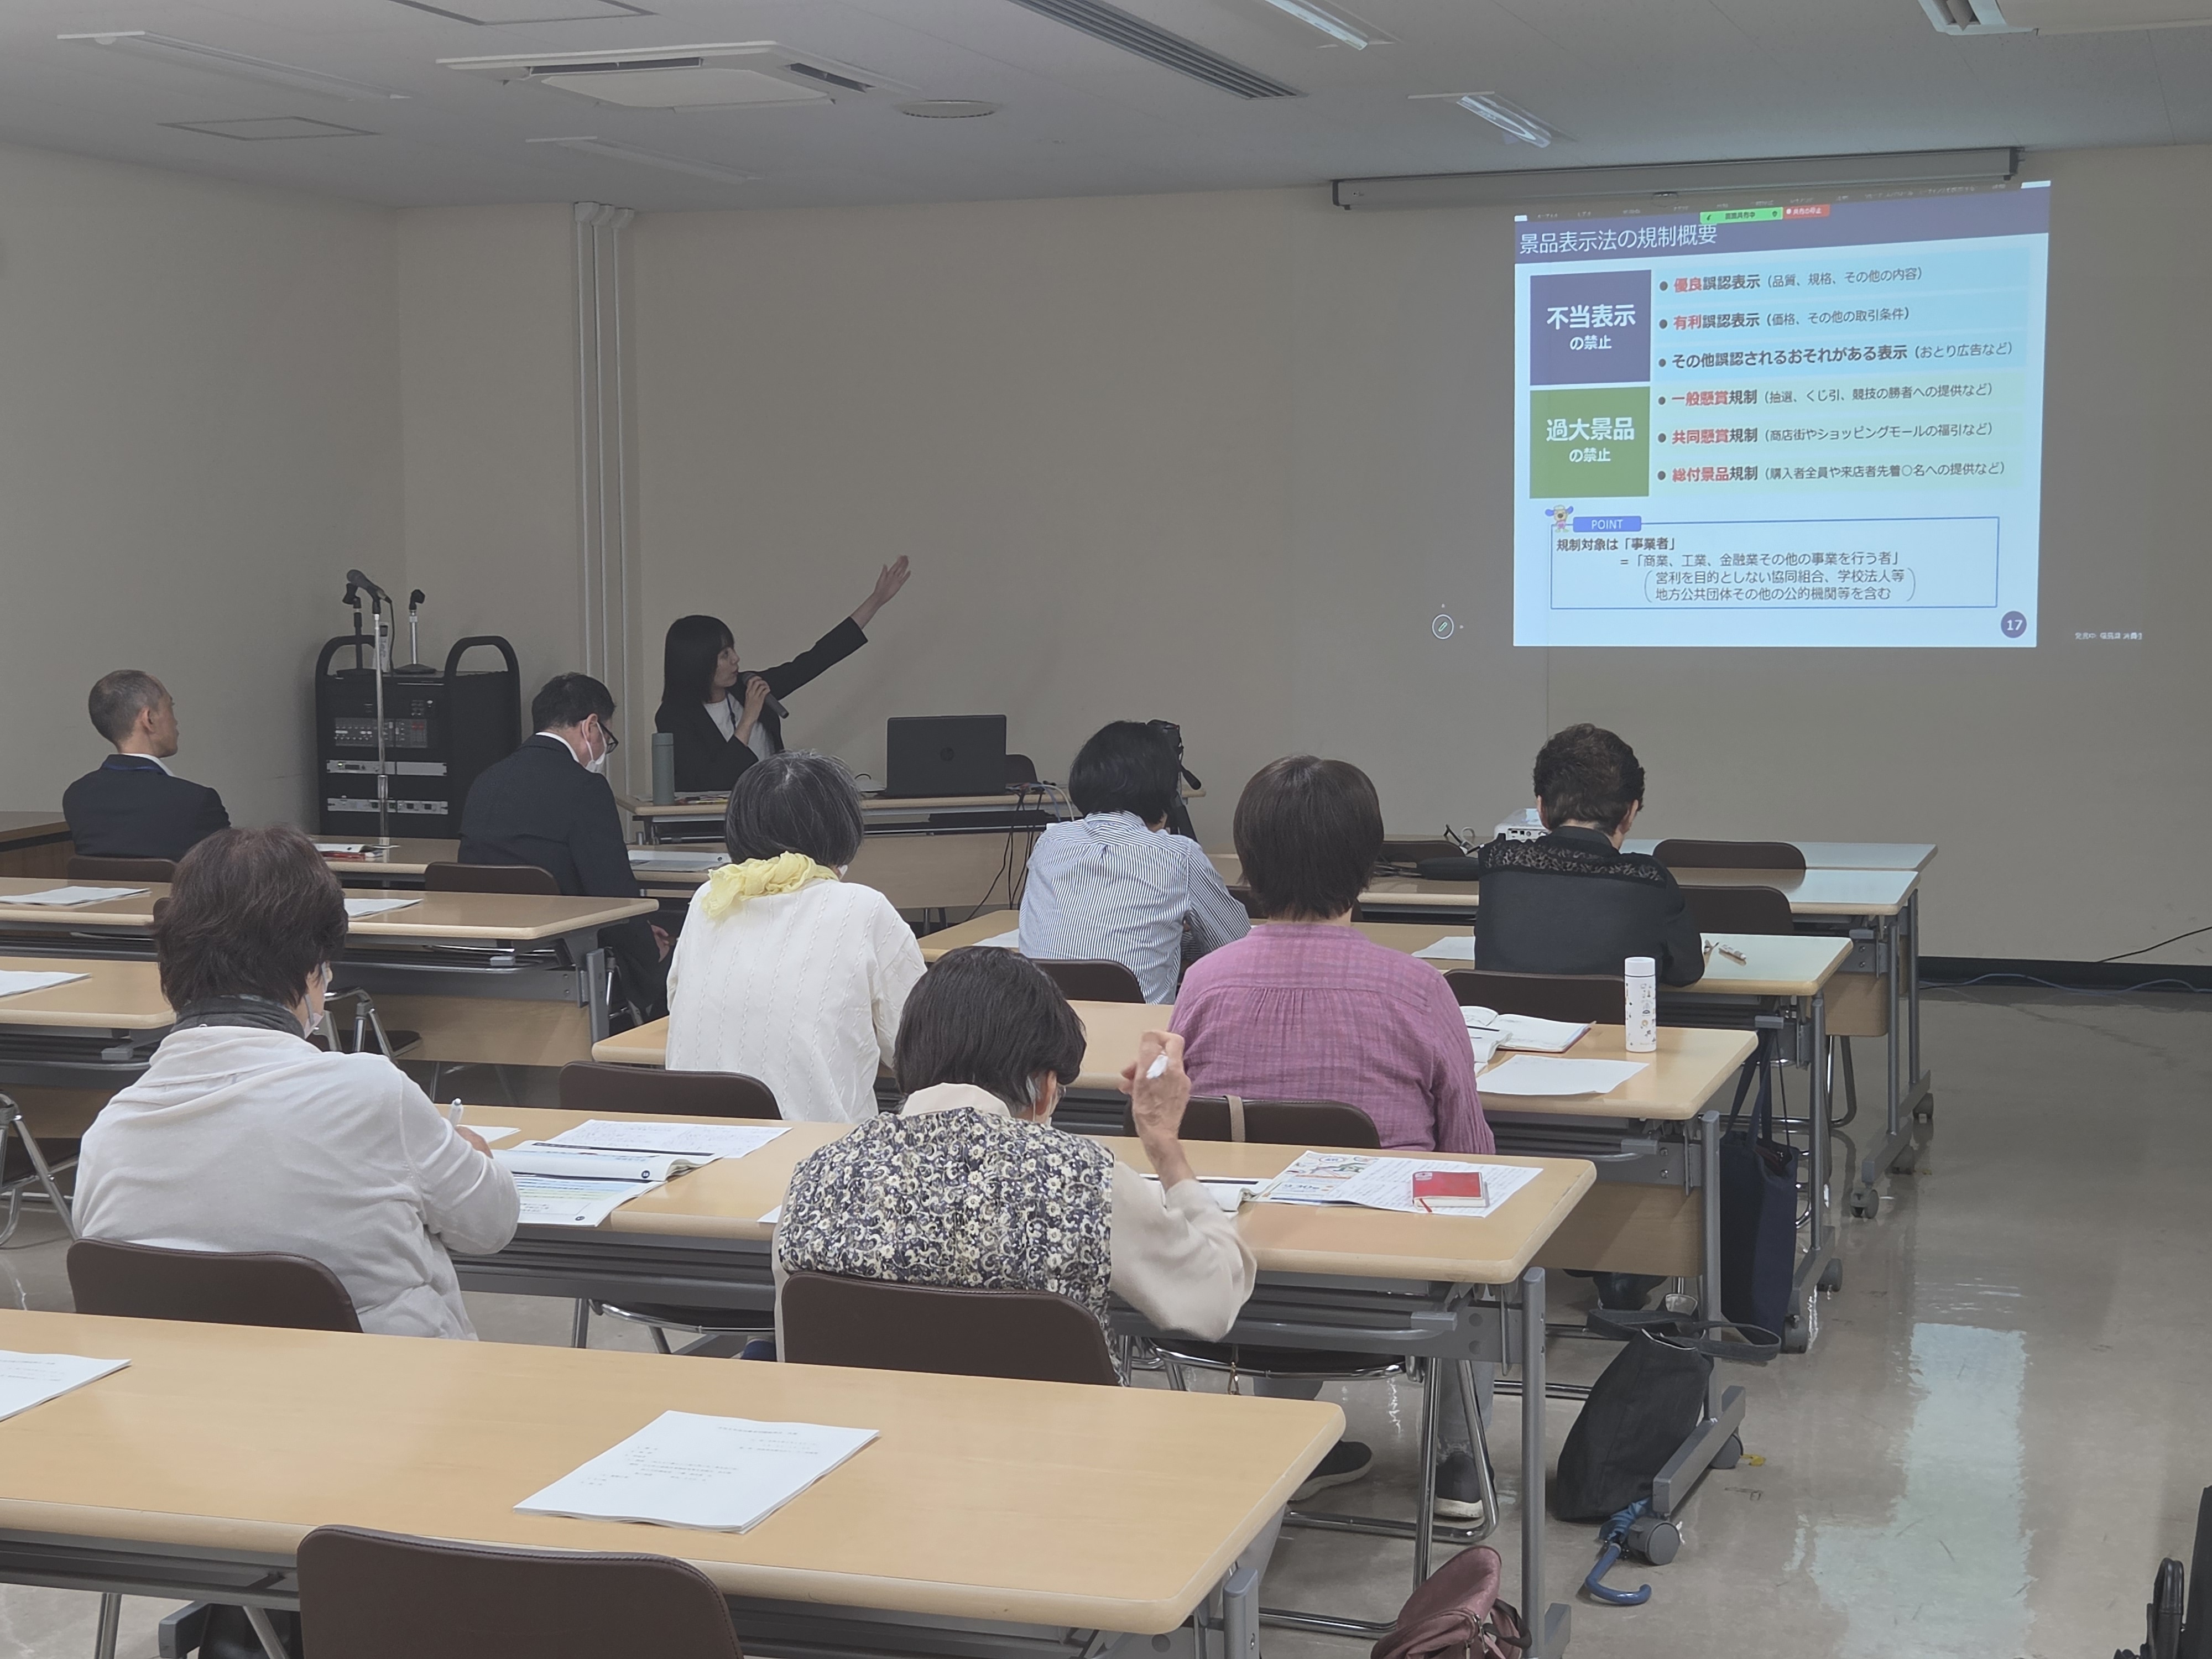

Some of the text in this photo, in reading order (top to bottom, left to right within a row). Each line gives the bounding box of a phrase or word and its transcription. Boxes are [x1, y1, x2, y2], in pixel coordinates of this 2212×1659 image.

[1520, 223, 1718, 254] 景品表示法の規制概要
[1547, 304, 1636, 330] 不当表示
[1569, 335, 1612, 350] の禁止
[1546, 417, 1635, 441] 過大景品
[1569, 447, 1611, 463] の禁止
[1591, 519, 1623, 529] POINT
[1556, 537, 1675, 551] 規制対象は「事業者」
[1656, 586, 1891, 601] 地方公共団体その他の公的機関等を含む
[2007, 619, 2023, 630] 17
